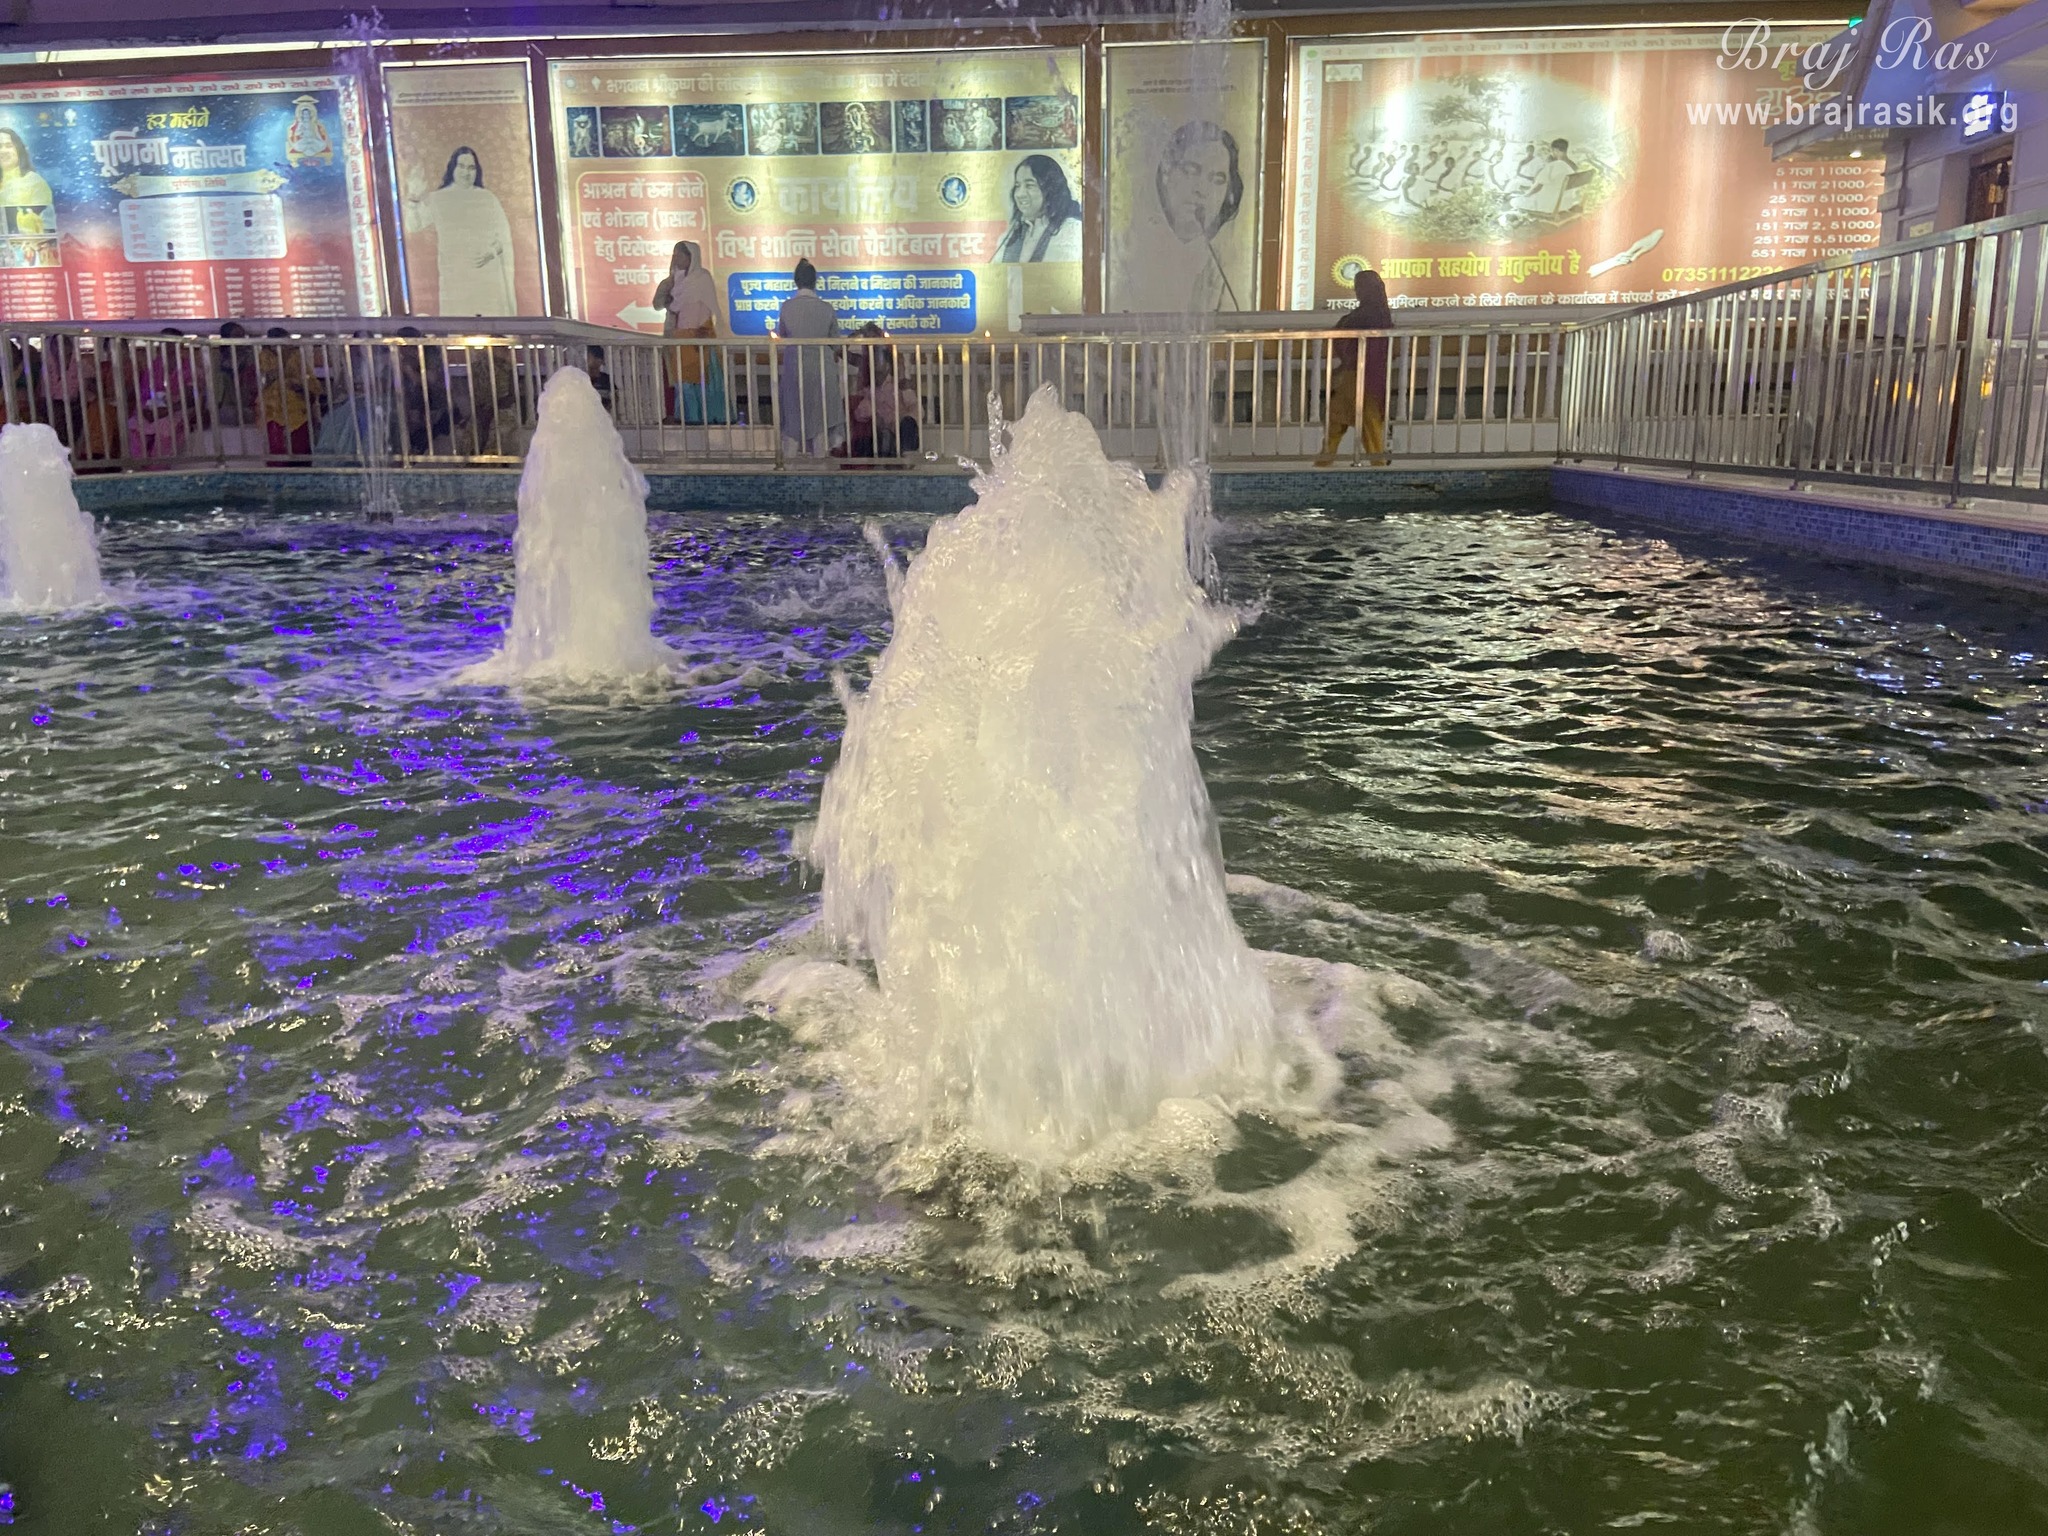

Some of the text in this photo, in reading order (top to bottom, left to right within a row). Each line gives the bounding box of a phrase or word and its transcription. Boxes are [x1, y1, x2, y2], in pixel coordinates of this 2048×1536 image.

[697, 73, 713, 92] की
[147, 105, 211, 130] हर महीने
[91, 127, 246, 177] पूर्णिमा महोत्सव
[1776, 167, 1785, 177] 5
[1789, 167, 1814, 176] गज
[582, 182, 627, 199] आश्रम
[628, 177, 645, 198] में
[646, 181, 674, 198] रूम
[676, 176, 705, 198] लेने
[775, 163, 919, 216] कार्यालय
[1773, 181, 1786, 190] 11
[1792, 181, 1817, 189] गज
[1769, 194, 1787, 204] 25
[1791, 194, 1816, 203] गज
[582, 207, 602, 228] एवं
[605, 206, 649, 228] भोजन
[653, 207, 697, 232] (प्रसाद
[1761, 208, 1777, 217] 51
[1782, 208, 1808, 217] गज
[1755, 222, 1778, 231] 151
[1784, 221, 1809, 230] गज
[594, 235, 616, 262] हेतु
[716, 226, 986, 259] विश्व शान्ति सेवा चैरीटेबल ट्रस्ट
[1753, 235, 1779, 244] 251
[1784, 235, 1810, 244] गज
[1751, 249, 1776, 258] 551
[1781, 249, 1807, 258] गज
[1380, 257, 1433, 279] आपका
[1437, 251, 1492, 278] सहयोग
[1568, 249, 1581, 275] है
[613, 264, 650, 286] संपर्क
[740, 279, 763, 295] पूज्य
[827, 275, 860, 291] मिलने
[861, 278, 869, 290] व
[870, 274, 901, 290] मिशन
[903, 274, 917, 290] की
[919, 273, 963, 289] जानकारी
[754, 295, 780, 311] करने
[824, 295, 857, 311] हयोग
[859, 294, 885, 310] करने
[886, 298, 894, 310] व
[896, 294, 925, 310] अधिक
[927, 292, 971, 309] जानकारी
[1430, 293, 1461, 308] करने
[1462, 293, 1477, 307] के
[1479, 292, 1502, 307] लिये
[1504, 292, 1538, 306] मिशन
[1540, 291, 1555, 305] के
[1557, 290, 1606, 305] कार्यालय
[1608, 289, 1619, 304] में
[1620, 289, 1654, 304] संपर्क
[764, 315, 777, 330] के
[886, 314, 918, 330] सम्पर्क
